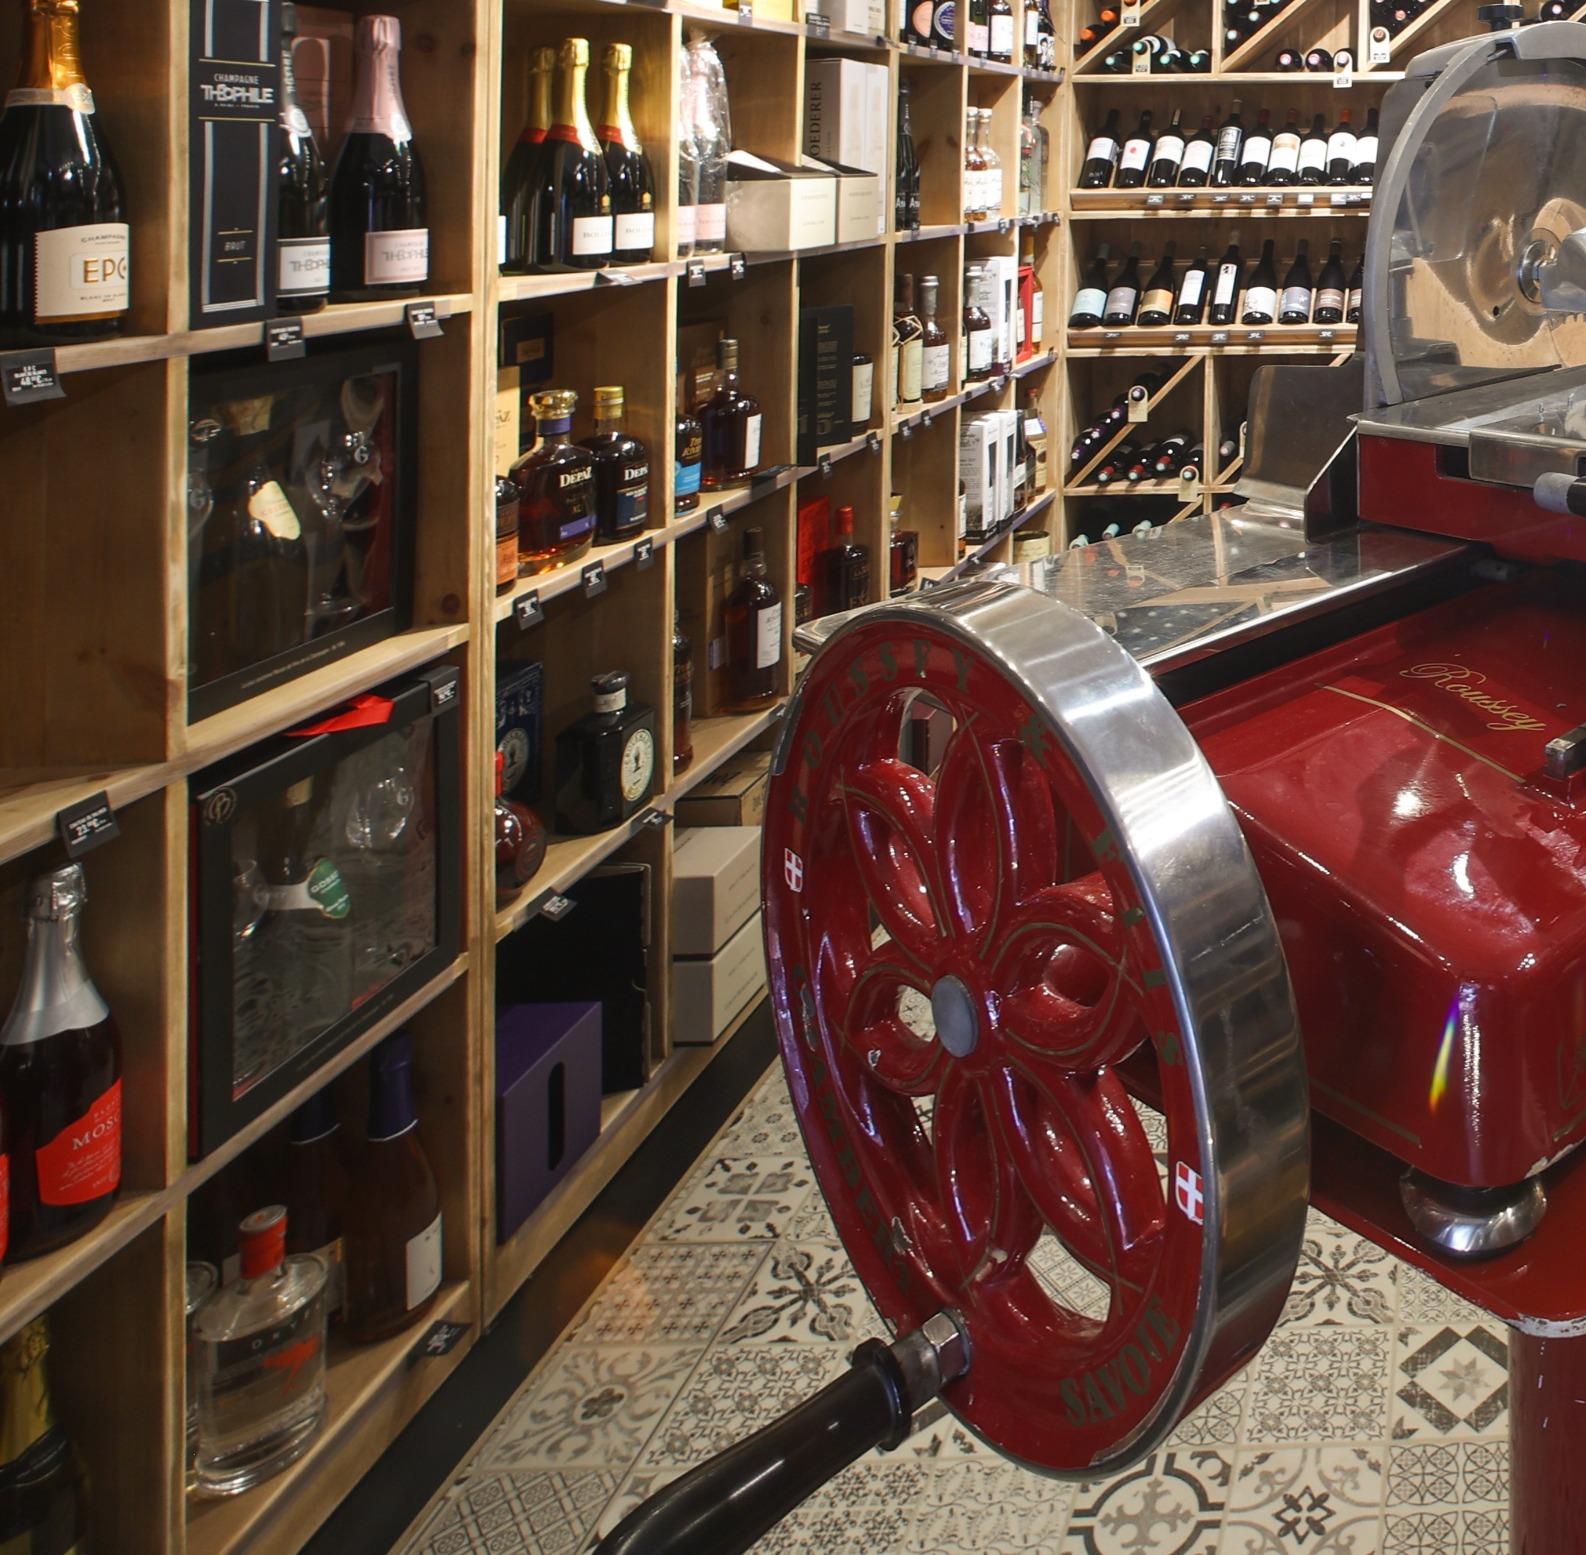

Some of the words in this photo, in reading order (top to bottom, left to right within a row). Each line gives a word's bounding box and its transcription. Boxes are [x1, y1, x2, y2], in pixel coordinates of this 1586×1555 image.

[214, 73, 260, 85] CHAMPAGNE
[224, 240, 247, 252] BRUT
[1400, 663, 1548, 731] Roussey
[1059, 1290, 1181, 1428] SAVOIE
